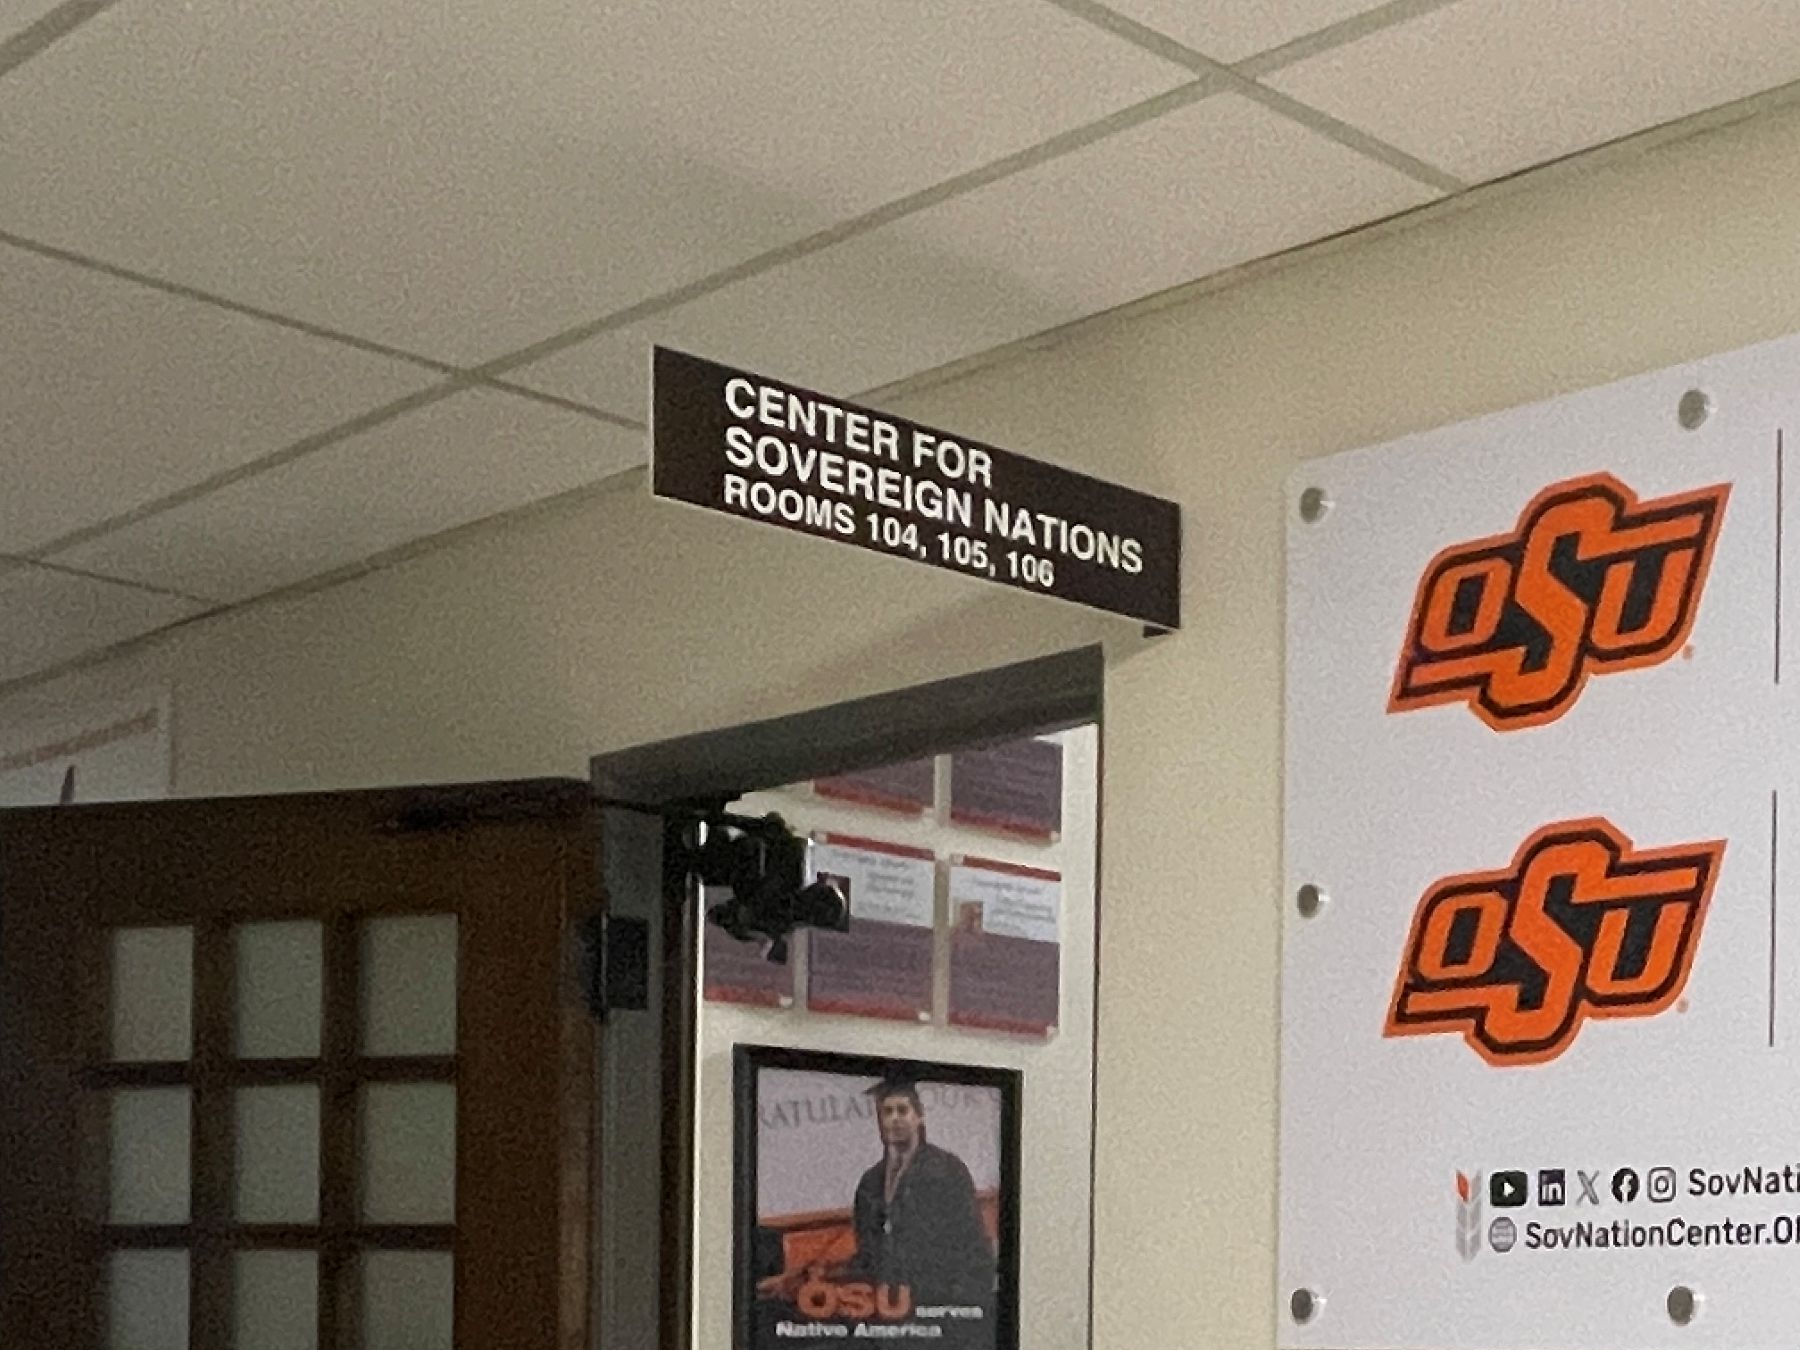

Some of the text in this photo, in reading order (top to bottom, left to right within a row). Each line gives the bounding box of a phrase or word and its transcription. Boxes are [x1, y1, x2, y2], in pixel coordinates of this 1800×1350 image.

[725, 378, 994, 488] CENTER FOR
[724, 473, 1056, 588] ROOMS 104, 105, 106
[725, 426, 1144, 574] SOVEREIGN NATIONS
[1387, 471, 1733, 733] OSU
[1382, 816, 1728, 1067] OSU
[775, 1320, 943, 1338] Native America
[797, 1281, 912, 1319] OSU
